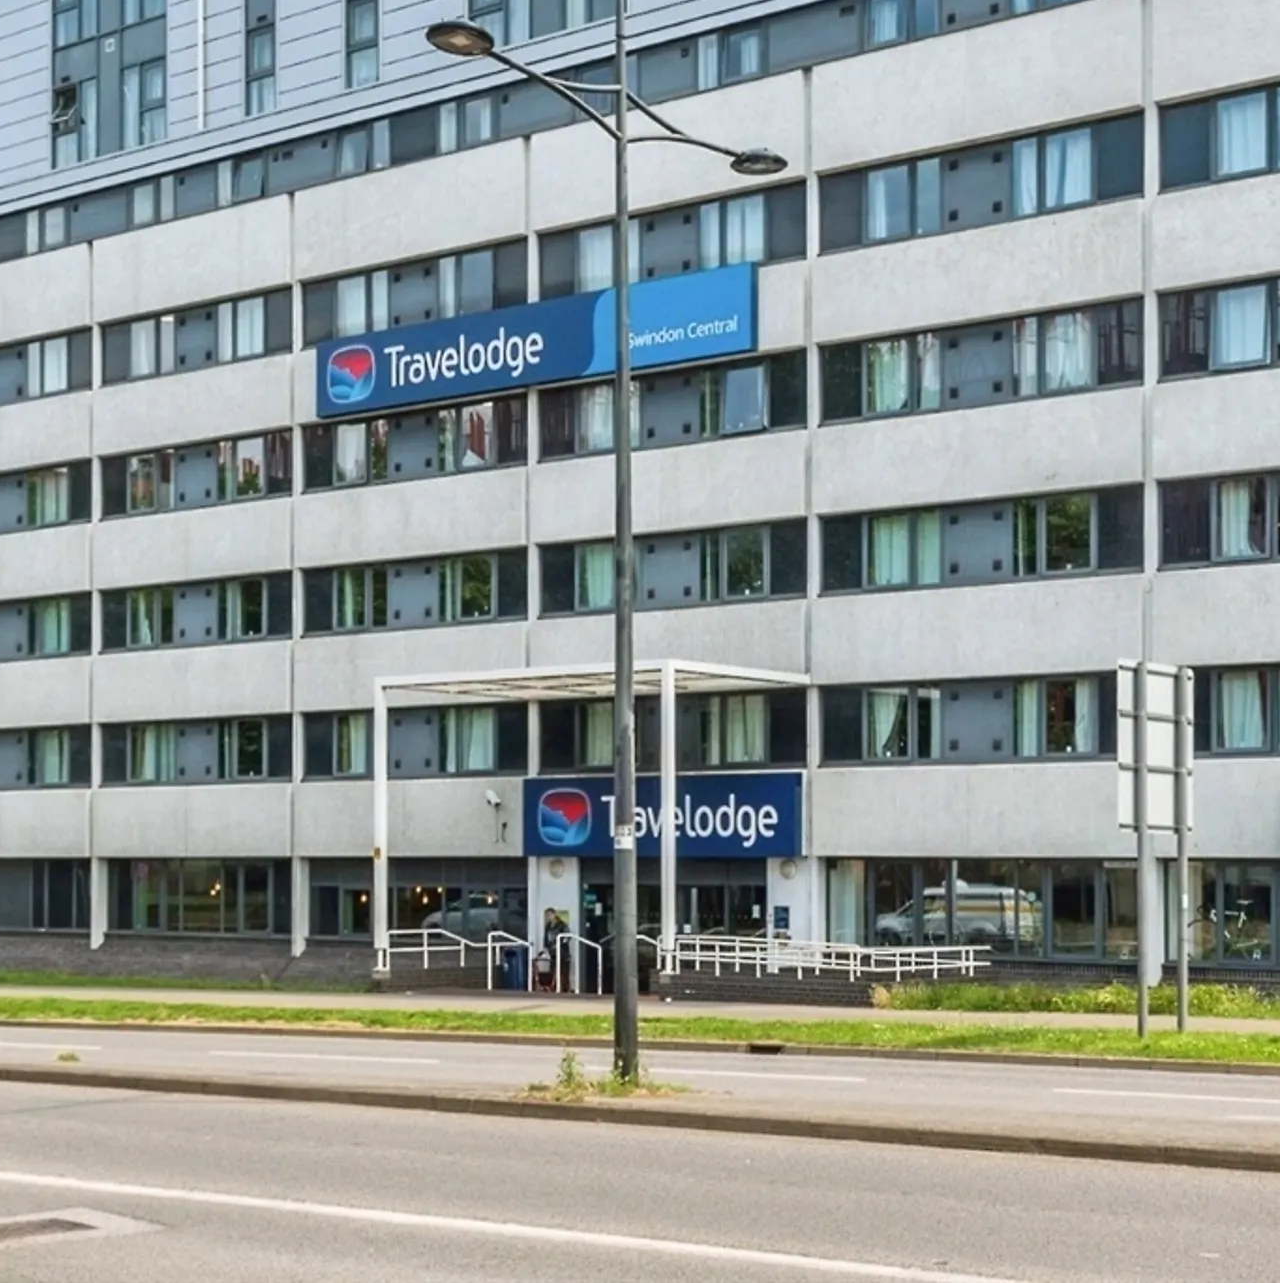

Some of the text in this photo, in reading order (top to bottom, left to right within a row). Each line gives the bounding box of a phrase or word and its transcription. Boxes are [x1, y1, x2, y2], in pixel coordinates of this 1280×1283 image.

[383, 327, 544, 388] Travelodge
[628, 314, 738, 350] Swindon Central
[600, 793, 779, 848] Tavlodge
